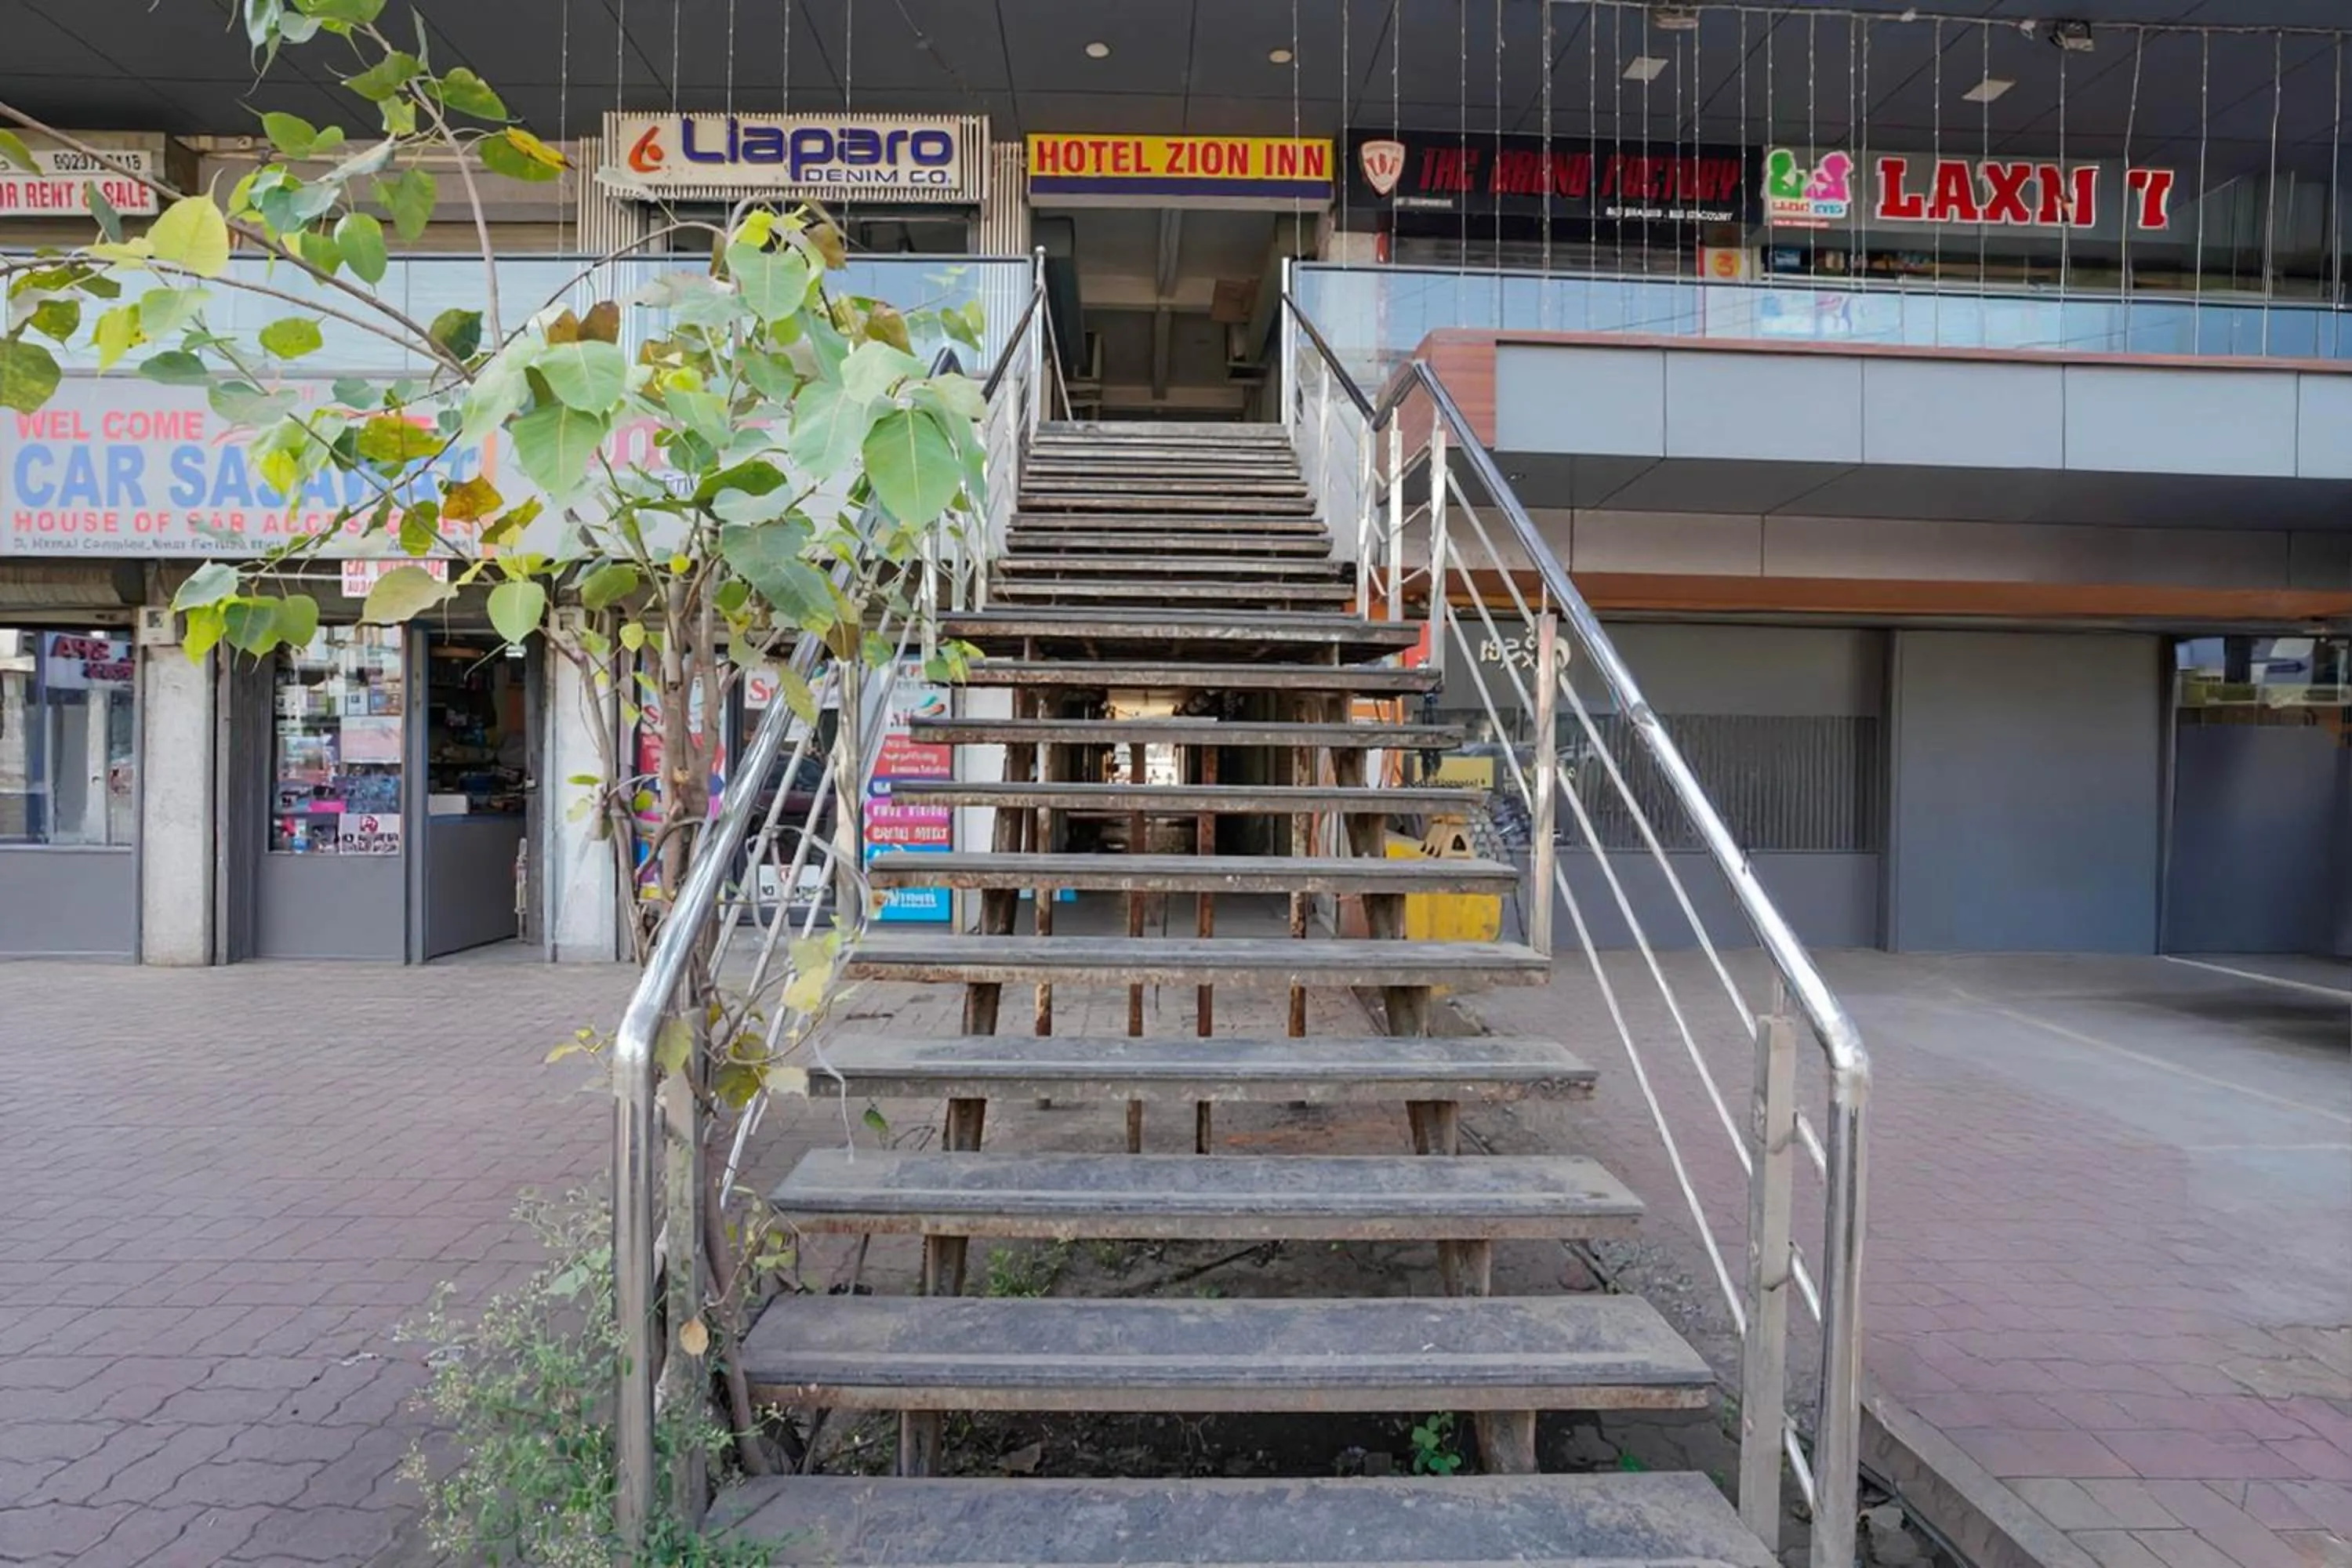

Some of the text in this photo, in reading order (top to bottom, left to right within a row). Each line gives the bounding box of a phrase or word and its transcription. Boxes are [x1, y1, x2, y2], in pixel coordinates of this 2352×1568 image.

[1036, 140, 1325, 176] HOTEL ZION INN
[1418, 148, 1479, 191] THE
[805, 169, 952, 184] DENIM CO.
[25, 182, 75, 208] RENT
[102, 181, 150, 209] SALE
[15, 409, 205, 441] WEL COME
[13, 443, 147, 508] CAR
[14, 511, 120, 533] HOUSE
[134, 511, 171, 534] OF
